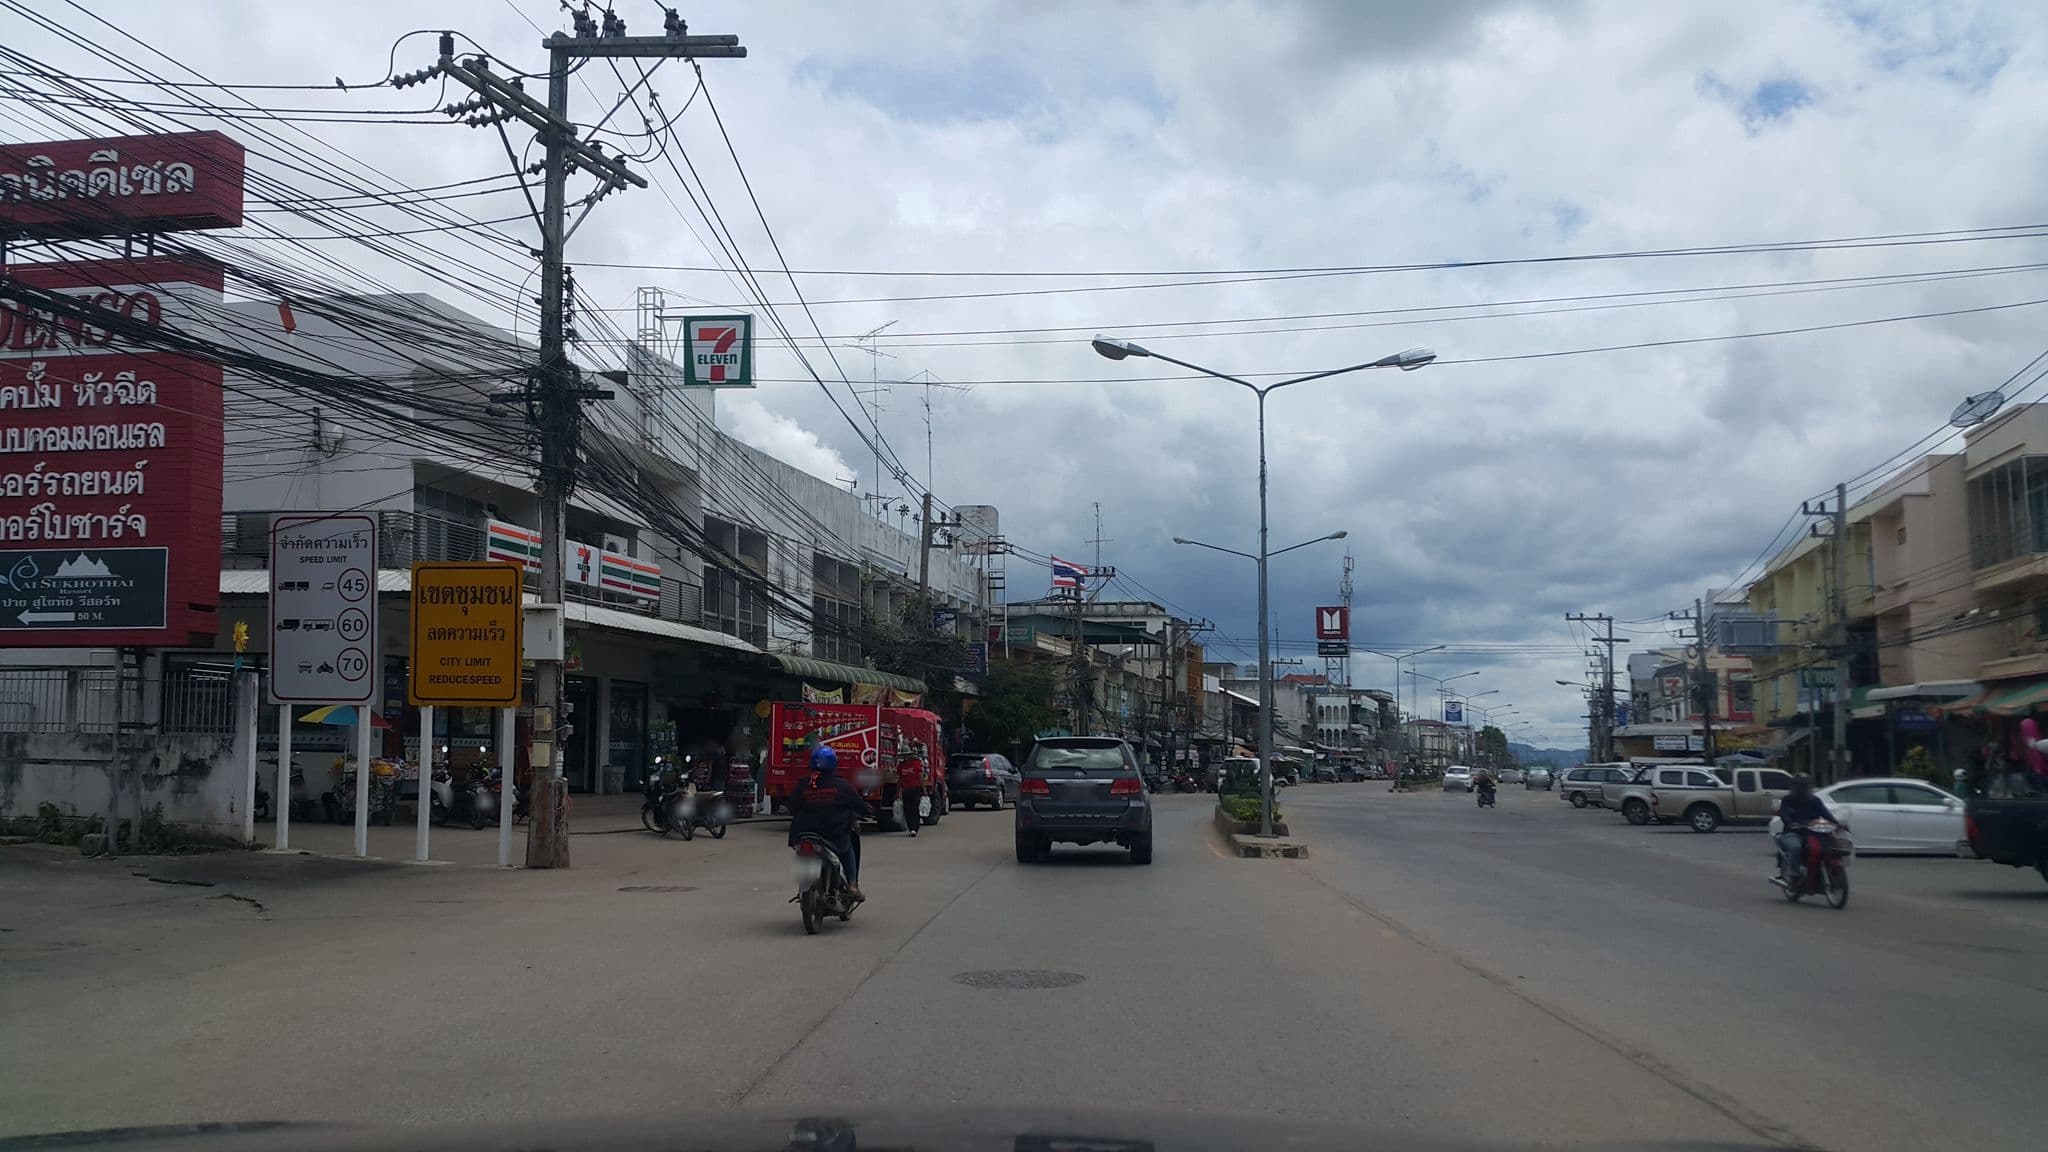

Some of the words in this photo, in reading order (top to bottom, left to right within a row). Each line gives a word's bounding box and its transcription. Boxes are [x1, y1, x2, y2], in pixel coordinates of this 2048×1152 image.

[73, 371, 157, 406] หัวฉีด
[0, 460, 148, 497] อร์รถยนต์
[281, 532, 368, 550] จำกัดความเร็ว
[300, 556, 324, 564] SPEED
[327, 556, 348, 564] LIMIT
[343, 579, 365, 592] 45
[421, 586, 513, 616] เขตชุมชน
[78, 612, 89, 620] 50
[342, 618, 363, 632] 60
[428, 620, 505, 641] ลดความเร็ว
[342, 658, 363, 671] 70
[440, 657, 461, 667] CITY
[465, 657, 492, 667] LIMIT
